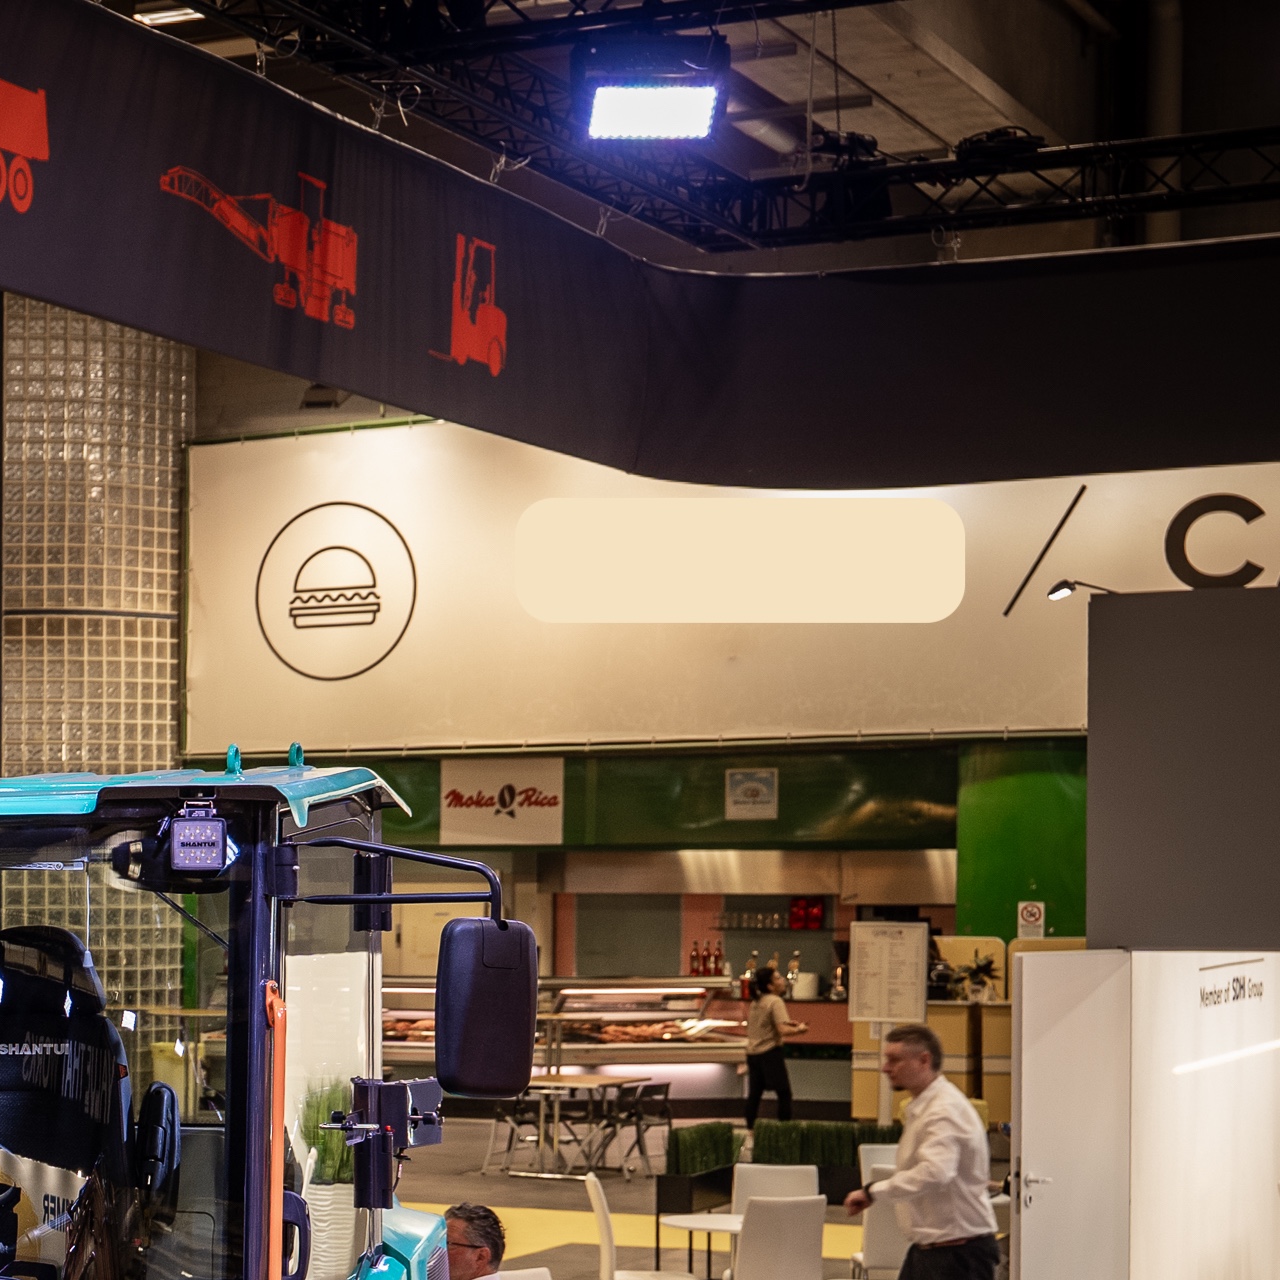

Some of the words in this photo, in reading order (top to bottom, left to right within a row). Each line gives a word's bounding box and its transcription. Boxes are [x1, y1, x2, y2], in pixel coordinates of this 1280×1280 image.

[1164, 492, 1280, 590] C
[444, 788, 496, 808] Moka
[517, 787, 559, 807] Rica
[1200, 986, 1222, 1008] Member
